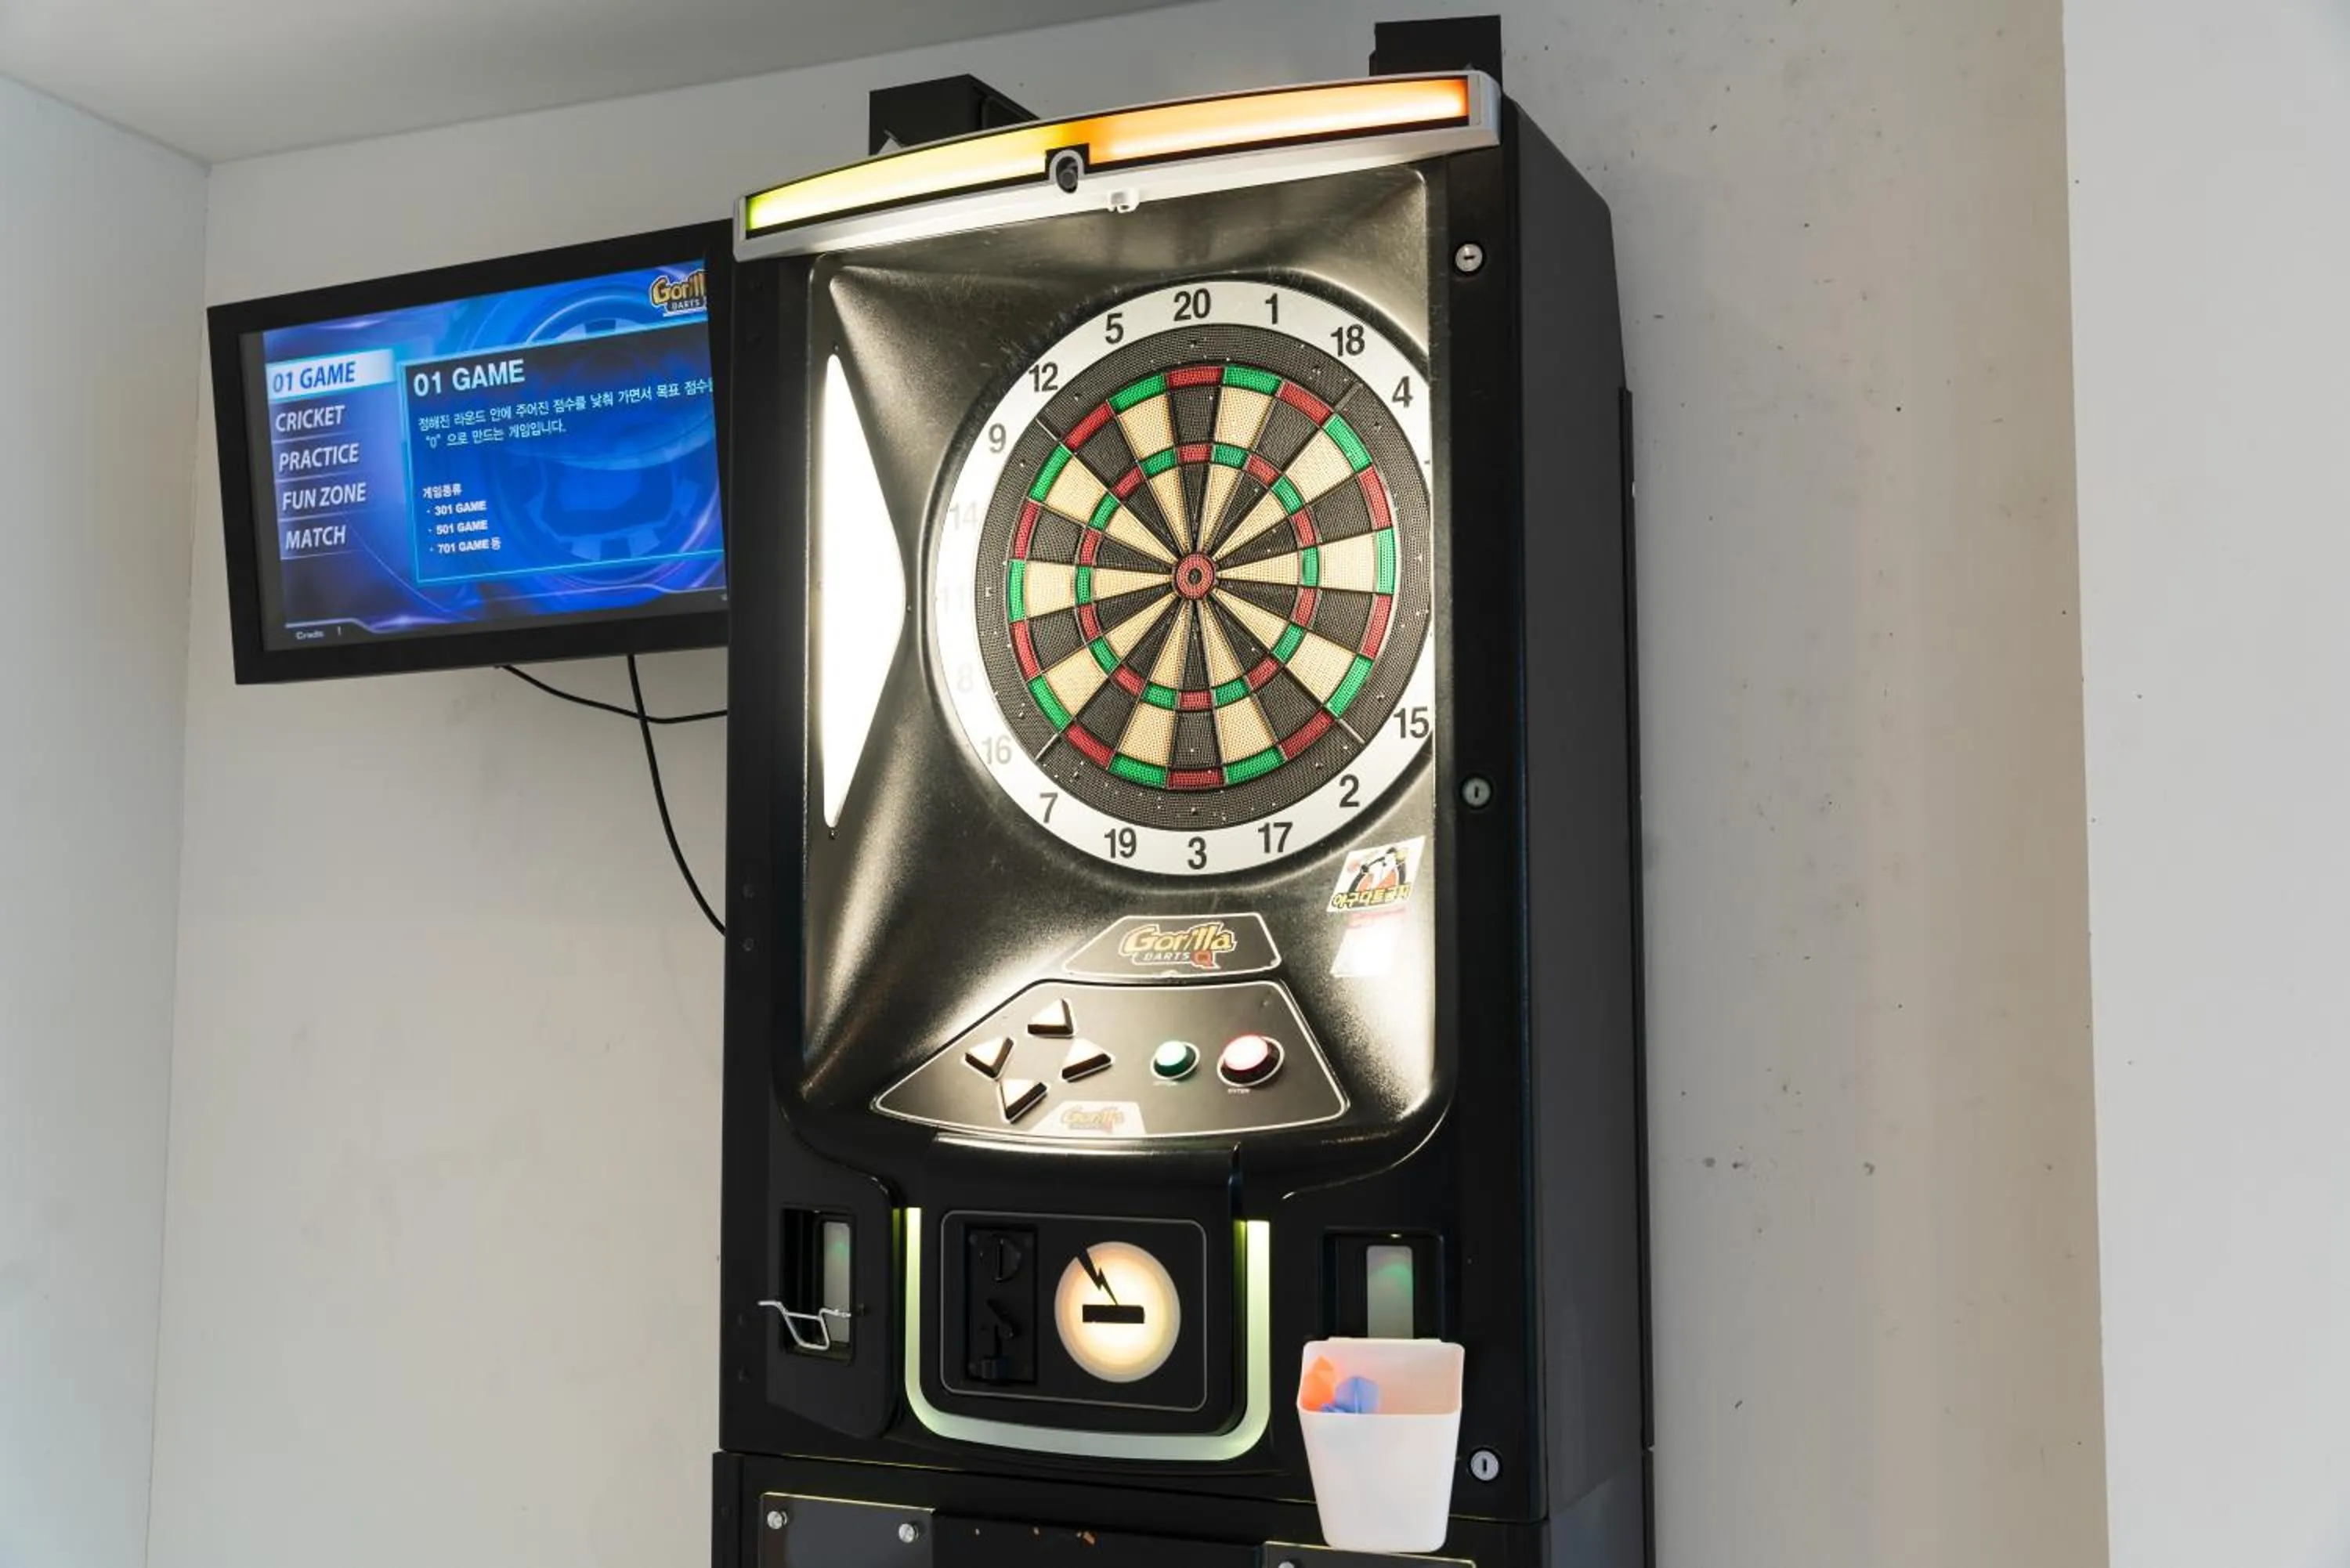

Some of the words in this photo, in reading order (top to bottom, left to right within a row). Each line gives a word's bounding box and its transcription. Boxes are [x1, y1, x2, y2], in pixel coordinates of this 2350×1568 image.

[652, 272, 705, 304] Gorill
[671, 299, 700, 310] DARTS
[1173, 288, 1212, 322] 20
[1265, 293, 1278, 325] 1
[1104, 313, 1124, 345] 5
[1330, 323, 1365, 358] 18
[274, 371, 293, 392] 01
[300, 361, 356, 389] GAME
[414, 371, 442, 396] 01
[452, 359, 526, 391] GAME
[1029, 362, 1059, 393] 12
[1391, 376, 1413, 408] 4
[276, 405, 345, 432] CRICKET
[454, 410, 486, 427] 라운드
[490, 405, 512, 422] 안에
[515, 400, 549, 417] 주어진
[553, 396, 587, 413] 점수를
[618, 386, 653, 404] 가면서
[656, 383, 681, 398] 목표
[446, 432, 468, 446] 으로
[472, 427, 504, 444] 만드는
[509, 418, 567, 439] 게임입니다.
[988, 424, 1007, 453] 9
[279, 443, 360, 471] PRACTICE
[283, 488, 316, 511] FUN
[320, 482, 367, 508] ZONE
[435, 504, 453, 516] 301
[455, 500, 487, 513] GAME
[436, 523, 454, 535] 501
[457, 519, 488, 533] GAME
[949, 500, 979, 531] 14
[285, 526, 346, 551] MATCH
[437, 542, 455, 554] 701
[458, 538, 489, 551] GAME
[1394, 706, 1430, 739] 15
[982, 735, 1013, 766] 16
[1340, 777, 1360, 808] 2
[1040, 793, 1058, 824] 7
[1104, 827, 1137, 859] 19
[1188, 836, 1208, 870] 3
[1258, 822, 1293, 854] 17
[1123, 925, 1233, 952] Gorilla
[1143, 952, 1191, 962] DARTS
